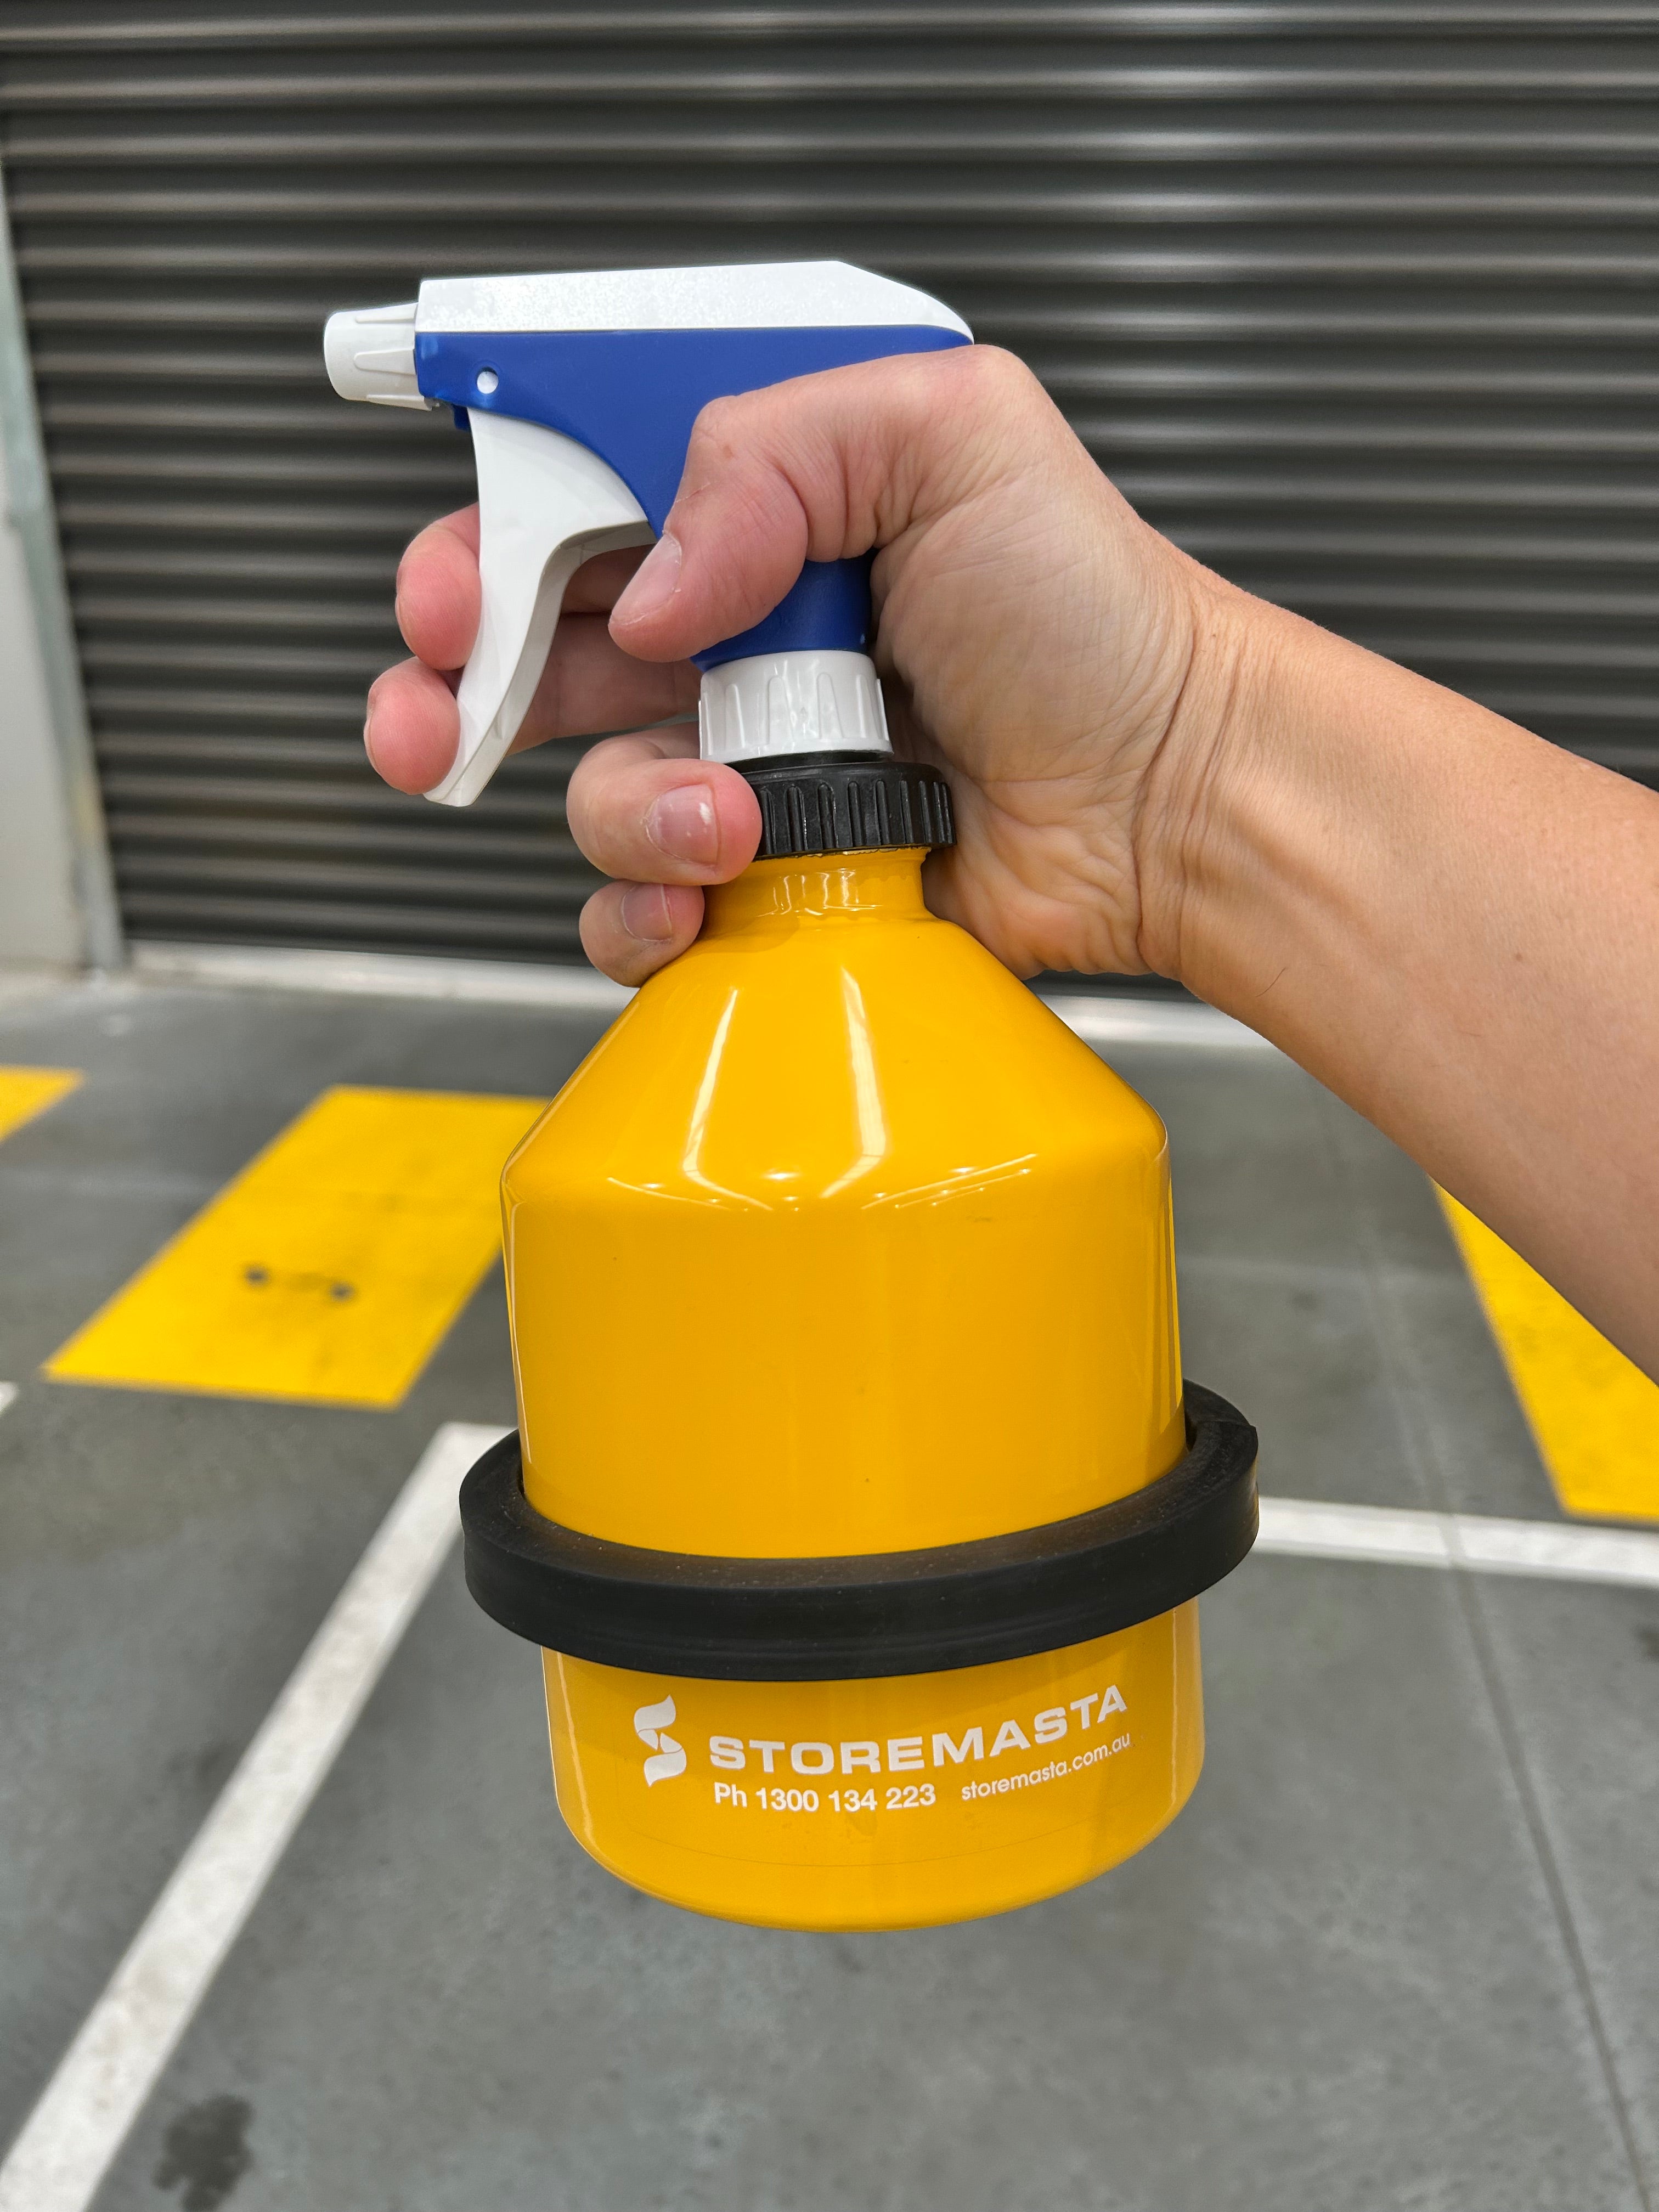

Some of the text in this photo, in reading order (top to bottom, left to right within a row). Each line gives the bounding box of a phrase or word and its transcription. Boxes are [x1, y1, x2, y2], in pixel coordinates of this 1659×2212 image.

[709, 1684, 1128, 1775] STOREMASTA
[714, 1781, 936, 1813] Ph 1300 134 223
[961, 1733, 1131, 1802] storemasta.com.au
